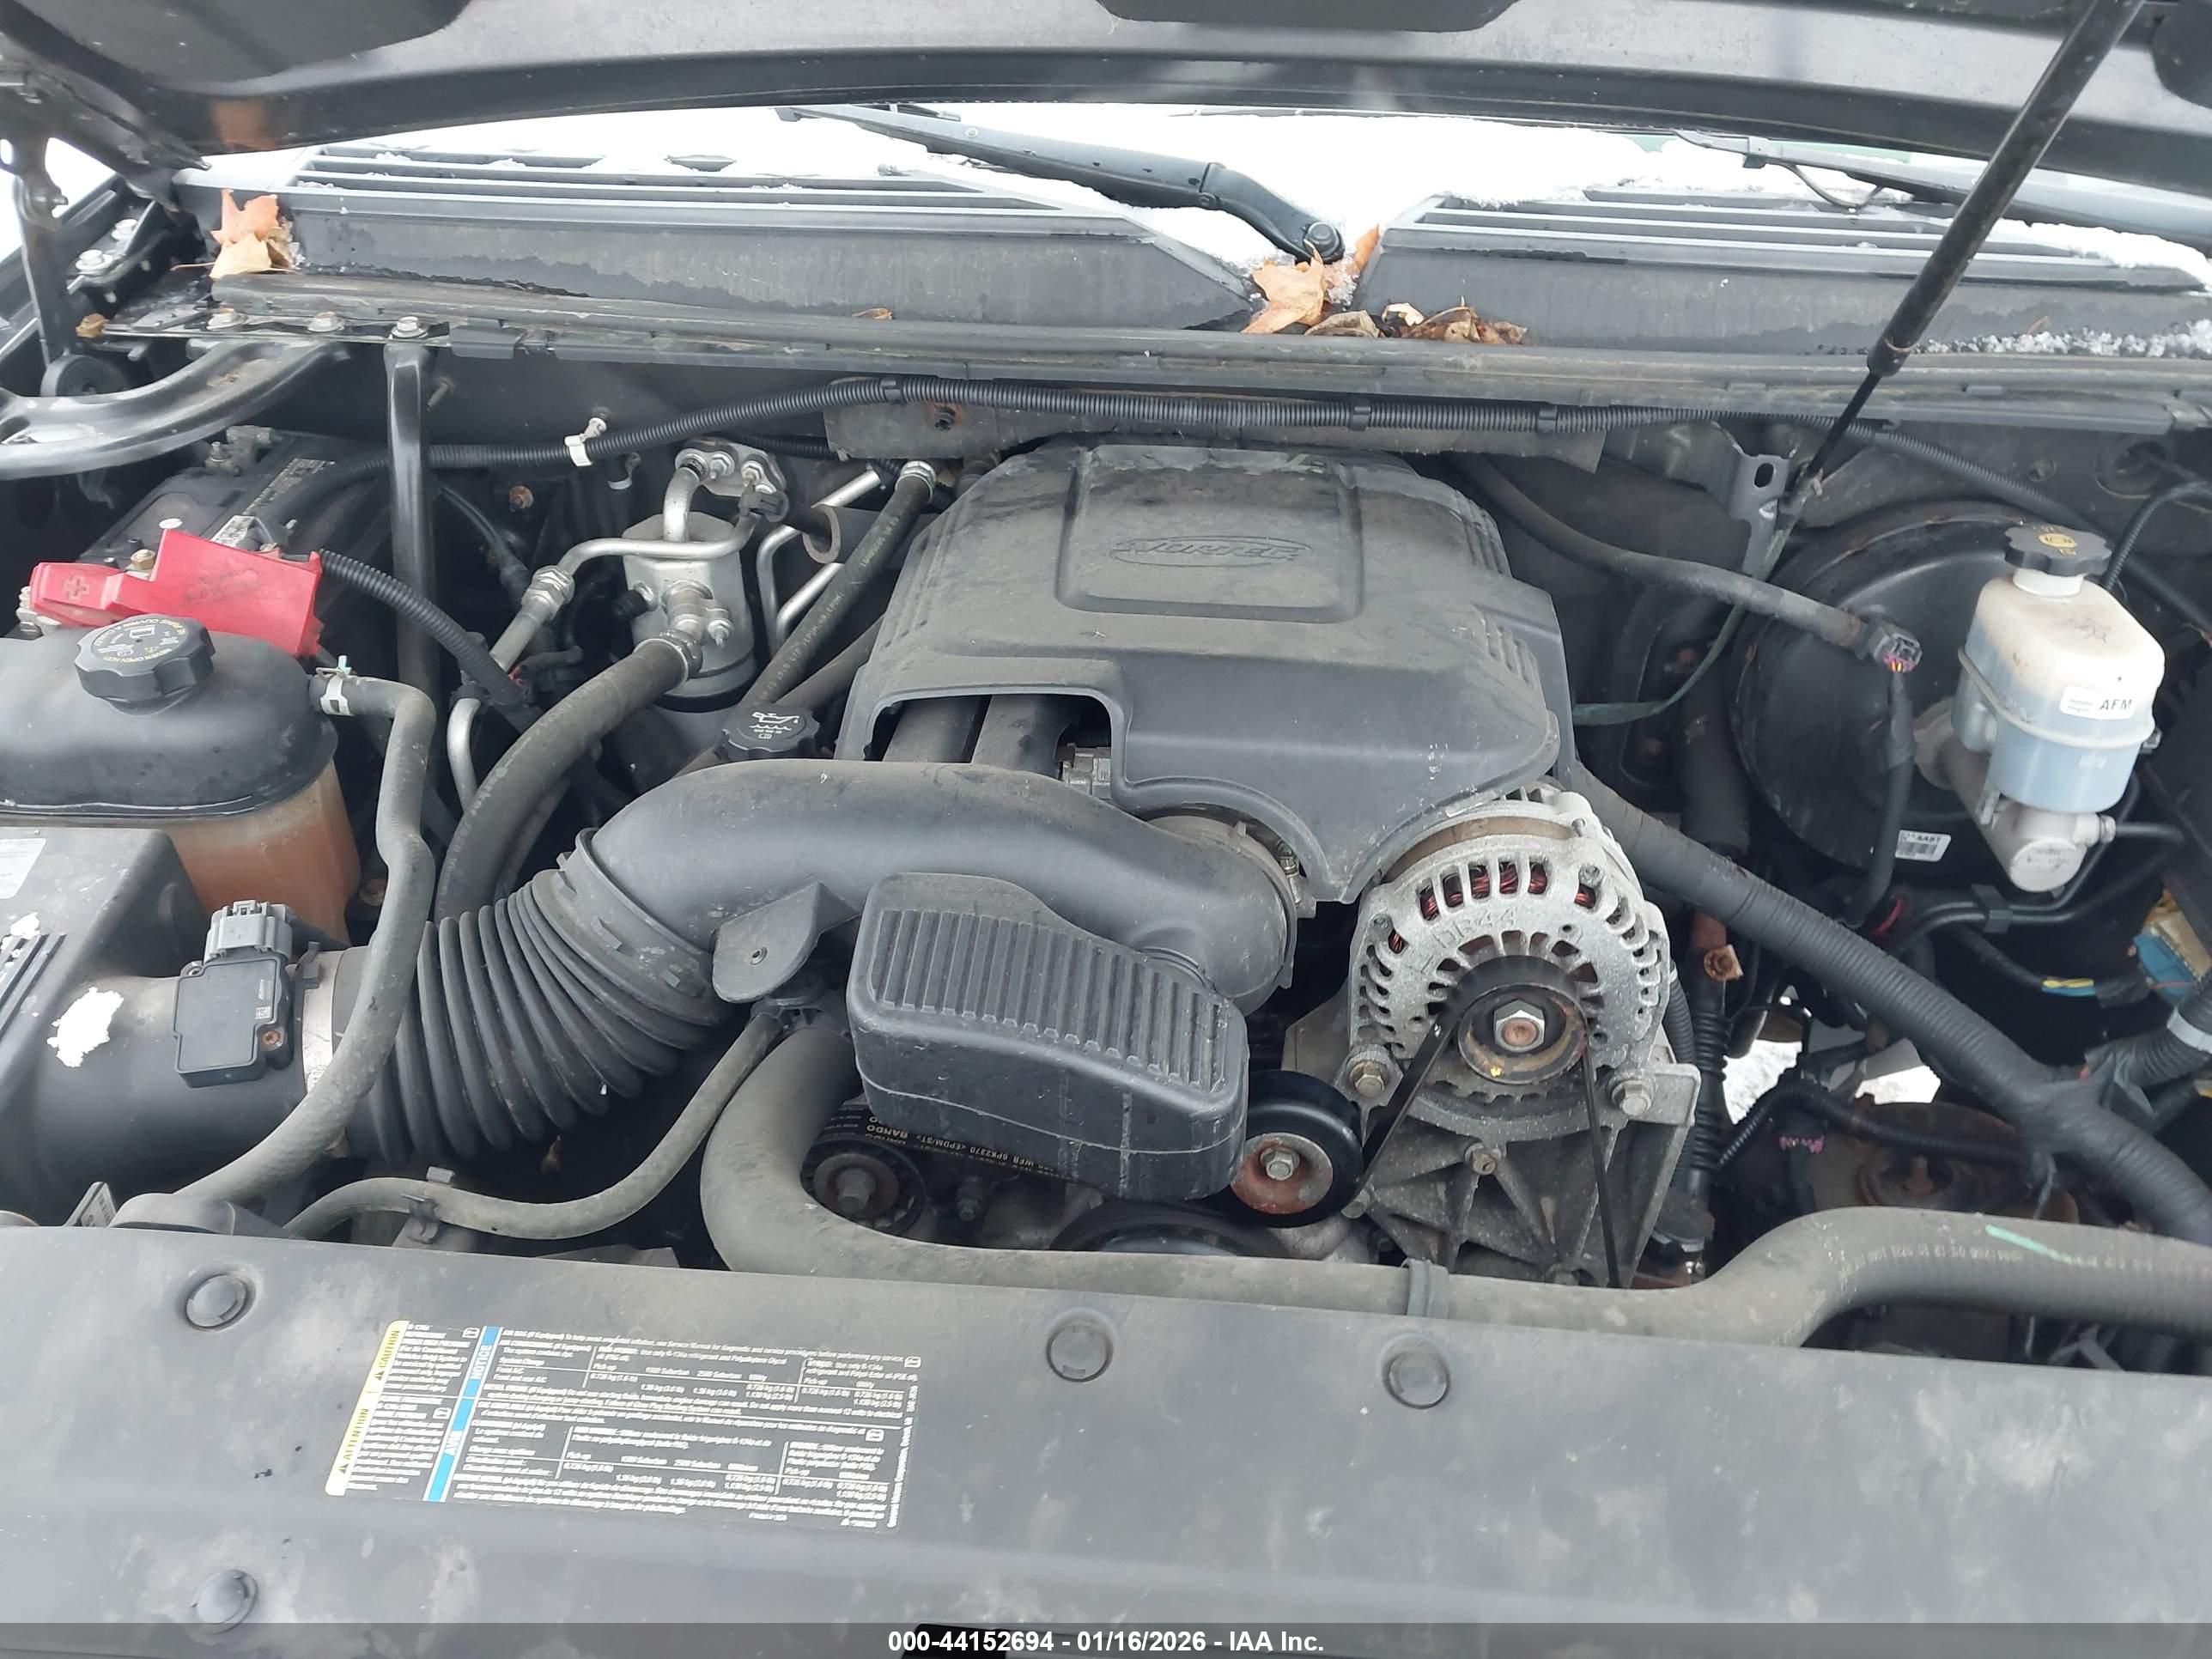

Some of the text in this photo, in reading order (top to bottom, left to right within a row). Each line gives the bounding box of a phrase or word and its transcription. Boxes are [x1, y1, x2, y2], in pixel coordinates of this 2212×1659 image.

[2099, 698, 2133, 711] AFM
[866, 1124, 908, 1139] BANDO
[969, 1146, 1008, 1161] 6PK2370
[376, 1329, 400, 1368] CAUTION
[470, 1345, 493, 1380] NOTICE
